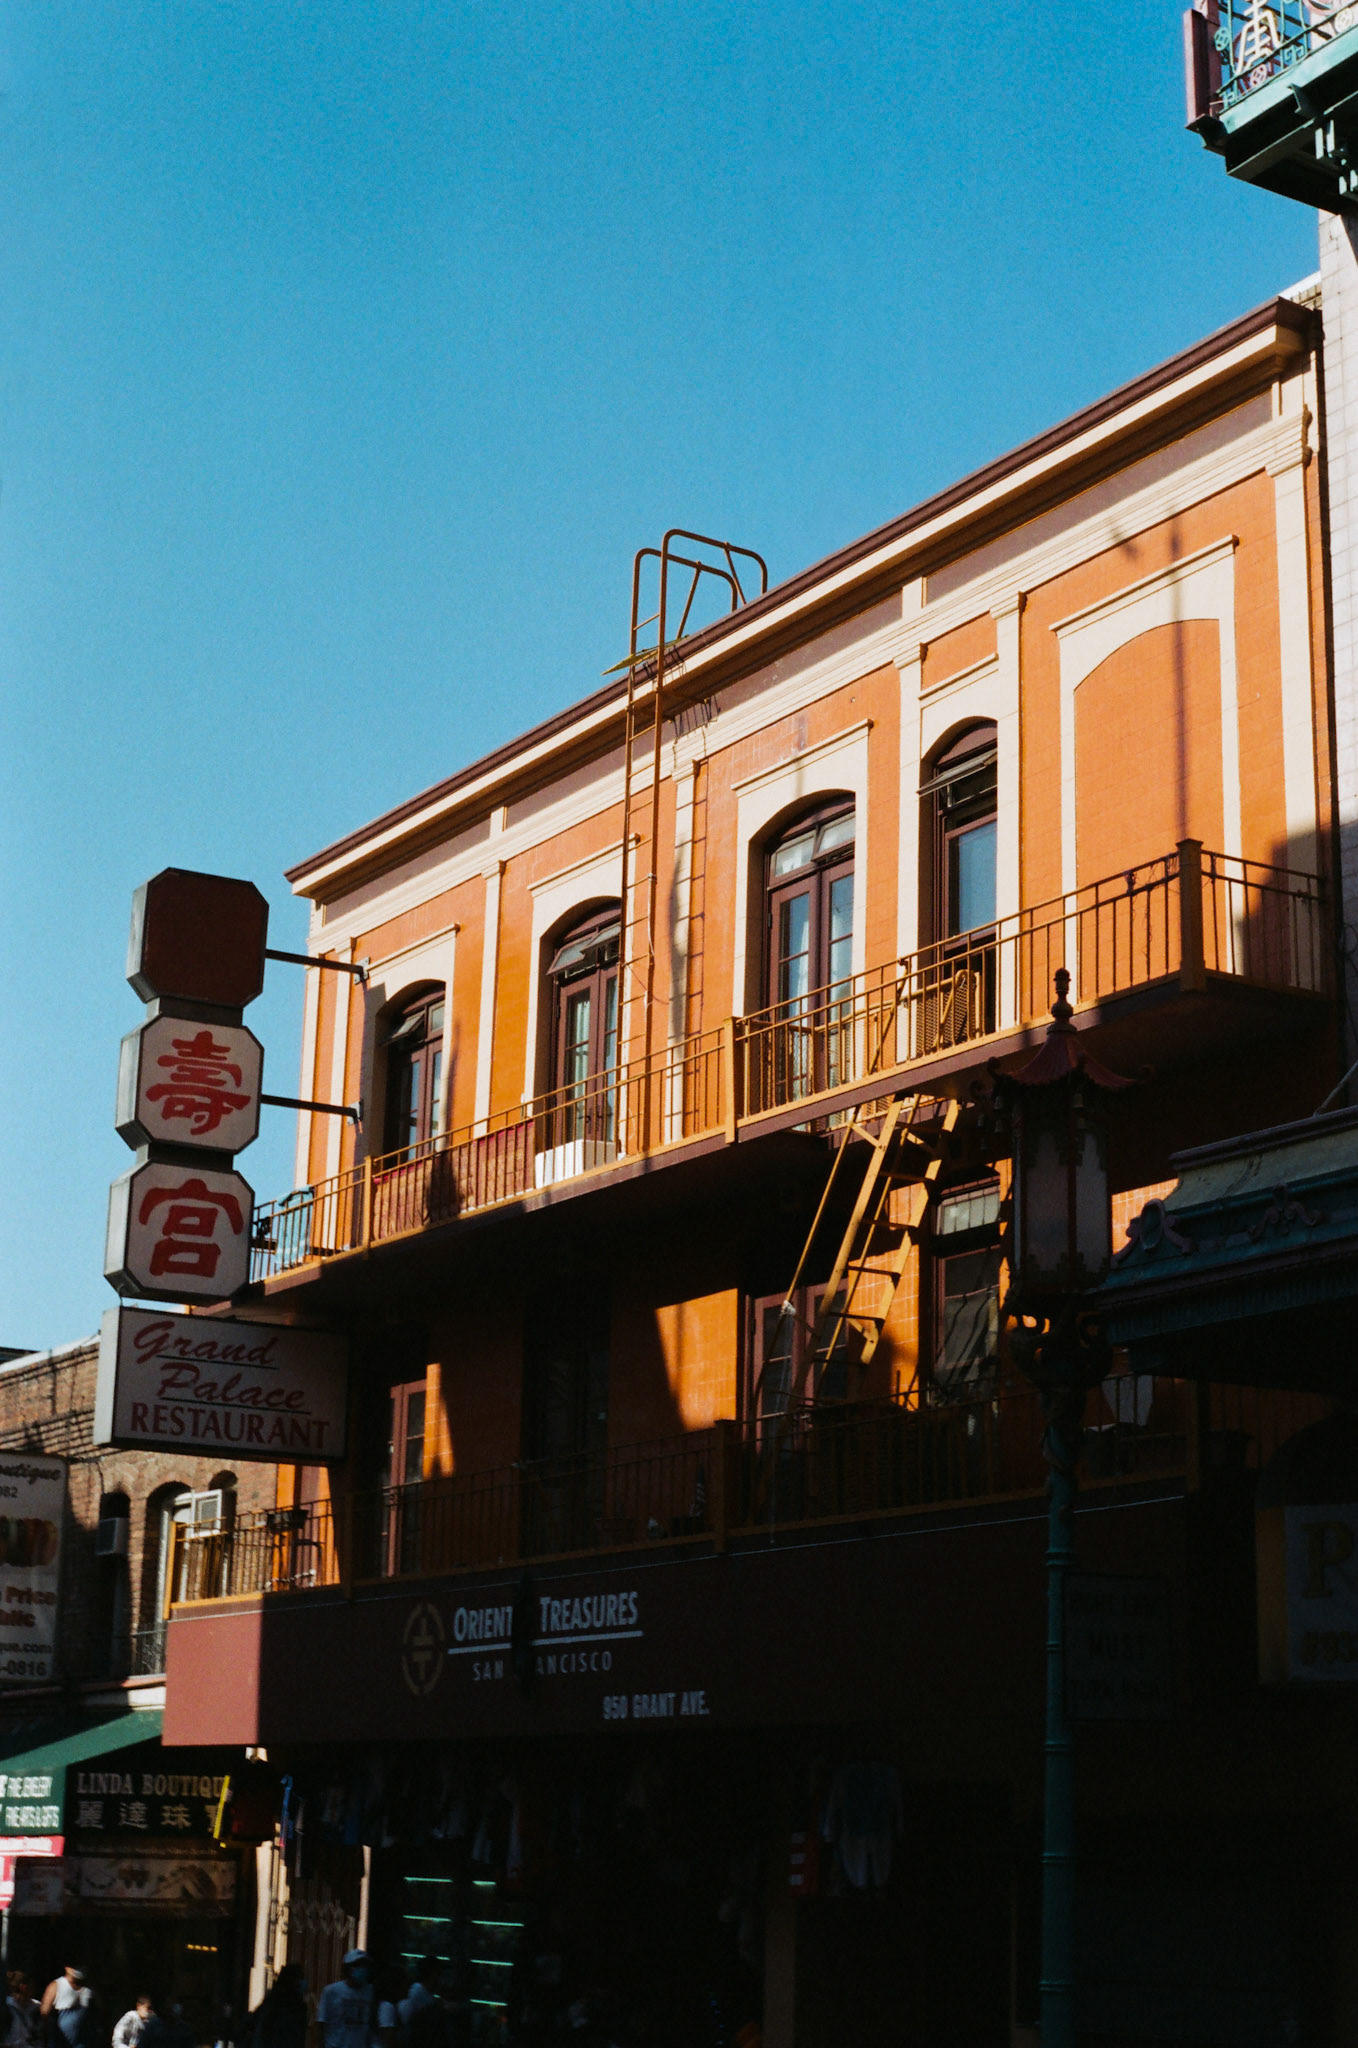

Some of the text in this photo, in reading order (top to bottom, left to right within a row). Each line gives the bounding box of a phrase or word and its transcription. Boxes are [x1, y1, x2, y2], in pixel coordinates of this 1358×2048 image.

[133, 1320, 278, 1364] Grand
[157, 1362, 305, 1409] Palace
[131, 1402, 329, 1448] RESTAURANT
[453, 1591, 639, 1641] ORIENT TREASURES
[473, 1651, 613, 1681] SAN ANCISCO
[632, 1692, 677, 1718] GRANT
[77, 1772, 225, 1799] LINDA BOUTIQU
